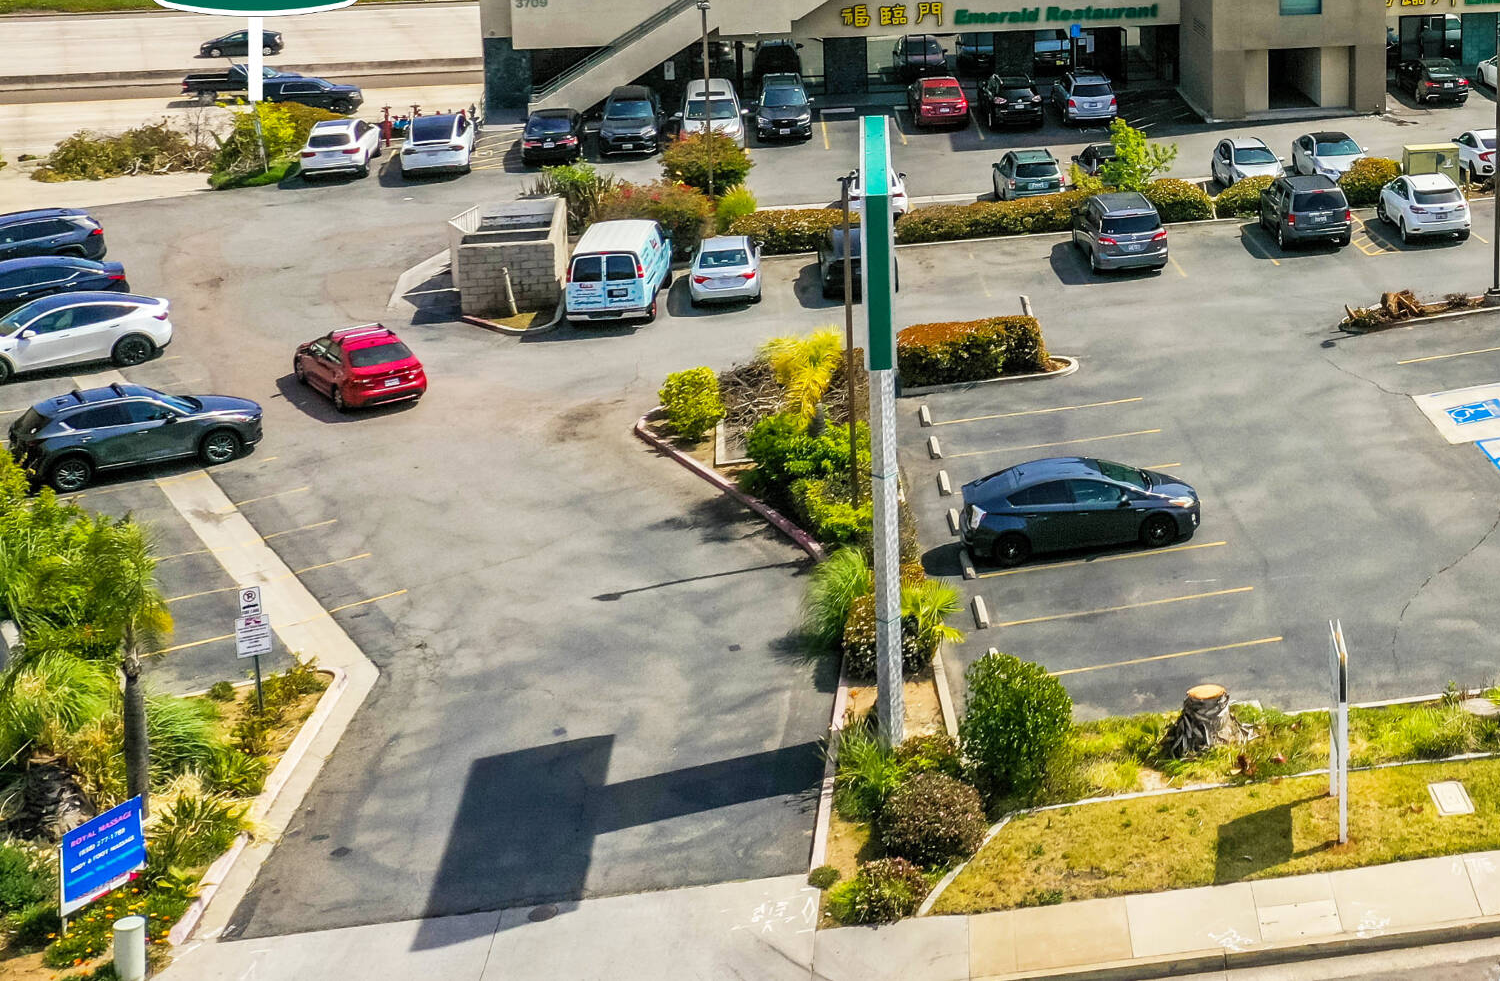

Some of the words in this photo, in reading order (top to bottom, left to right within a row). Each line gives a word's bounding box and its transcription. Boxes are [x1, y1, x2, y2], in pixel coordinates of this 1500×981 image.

[841, 2, 943, 27] 福臨門
[954, 7, 1040, 25] Emerald
[1046, 3, 1158, 22] Restaurant
[70, 830, 97, 848] ROYAL
[98, 810, 132, 833] MASSAGE
